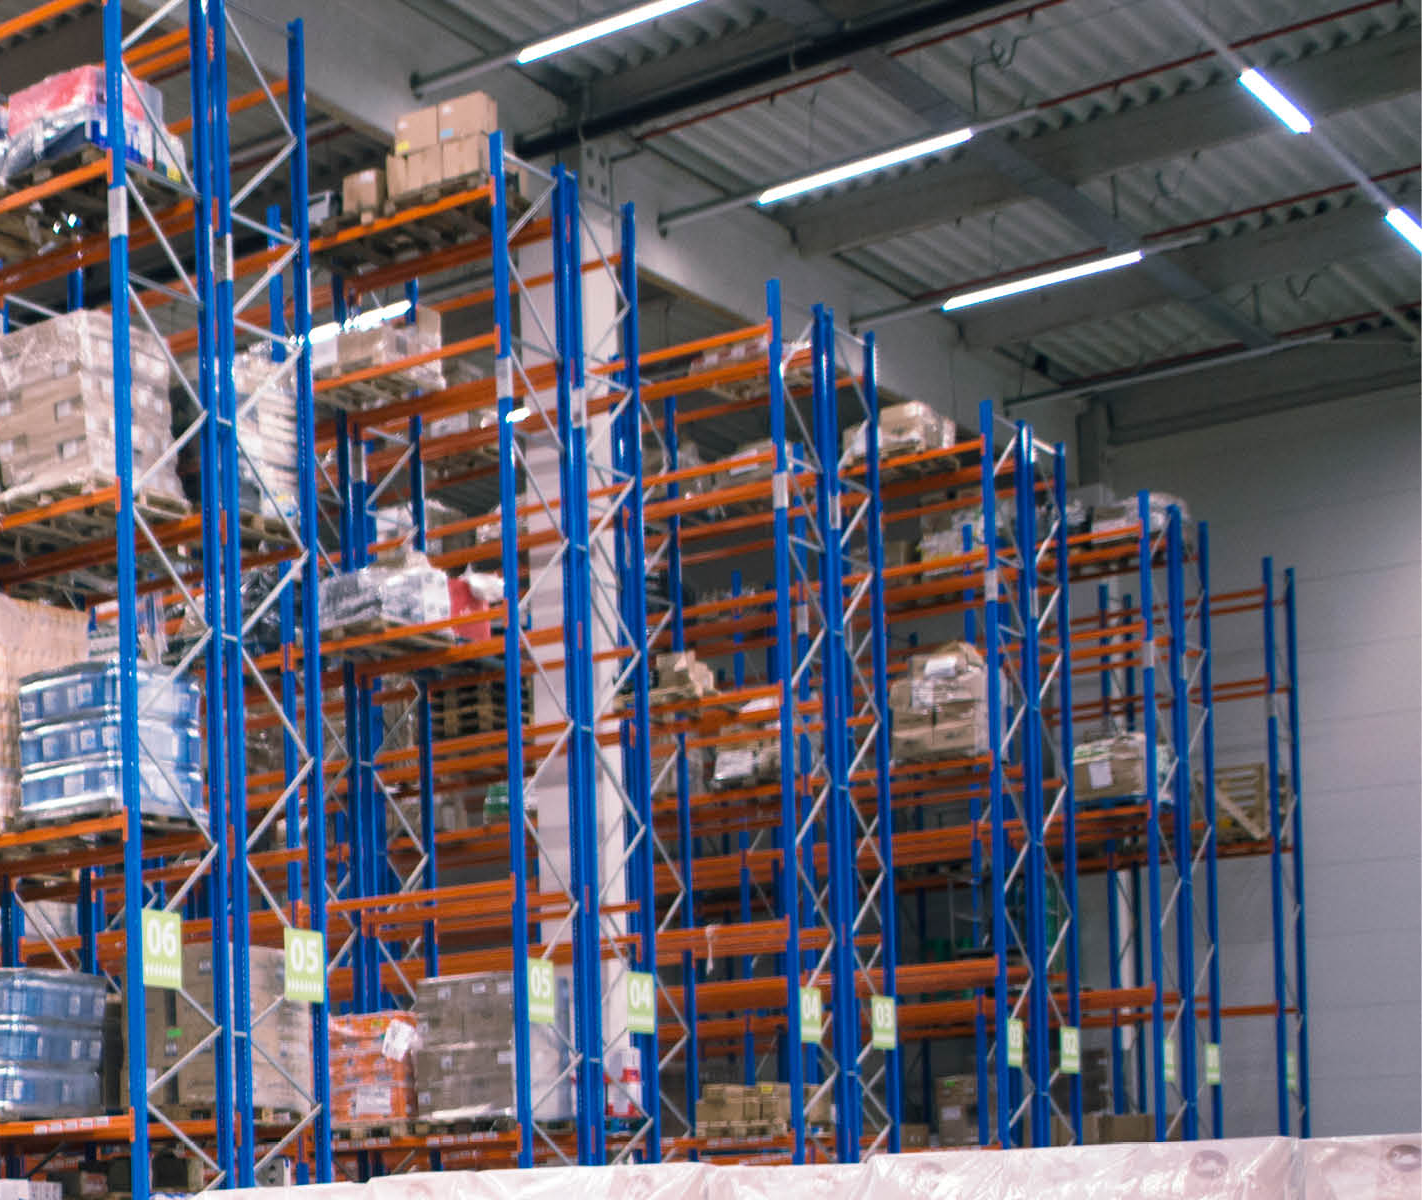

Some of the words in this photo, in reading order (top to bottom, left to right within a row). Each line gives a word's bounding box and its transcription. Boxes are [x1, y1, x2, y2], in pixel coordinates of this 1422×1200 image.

[147, 918, 177, 958] 06
[290, 937, 319, 974] 05
[531, 966, 552, 998] 05
[630, 977, 653, 1009] 04
[801, 993, 821, 1020] 04
[874, 1002, 893, 1030] 03
